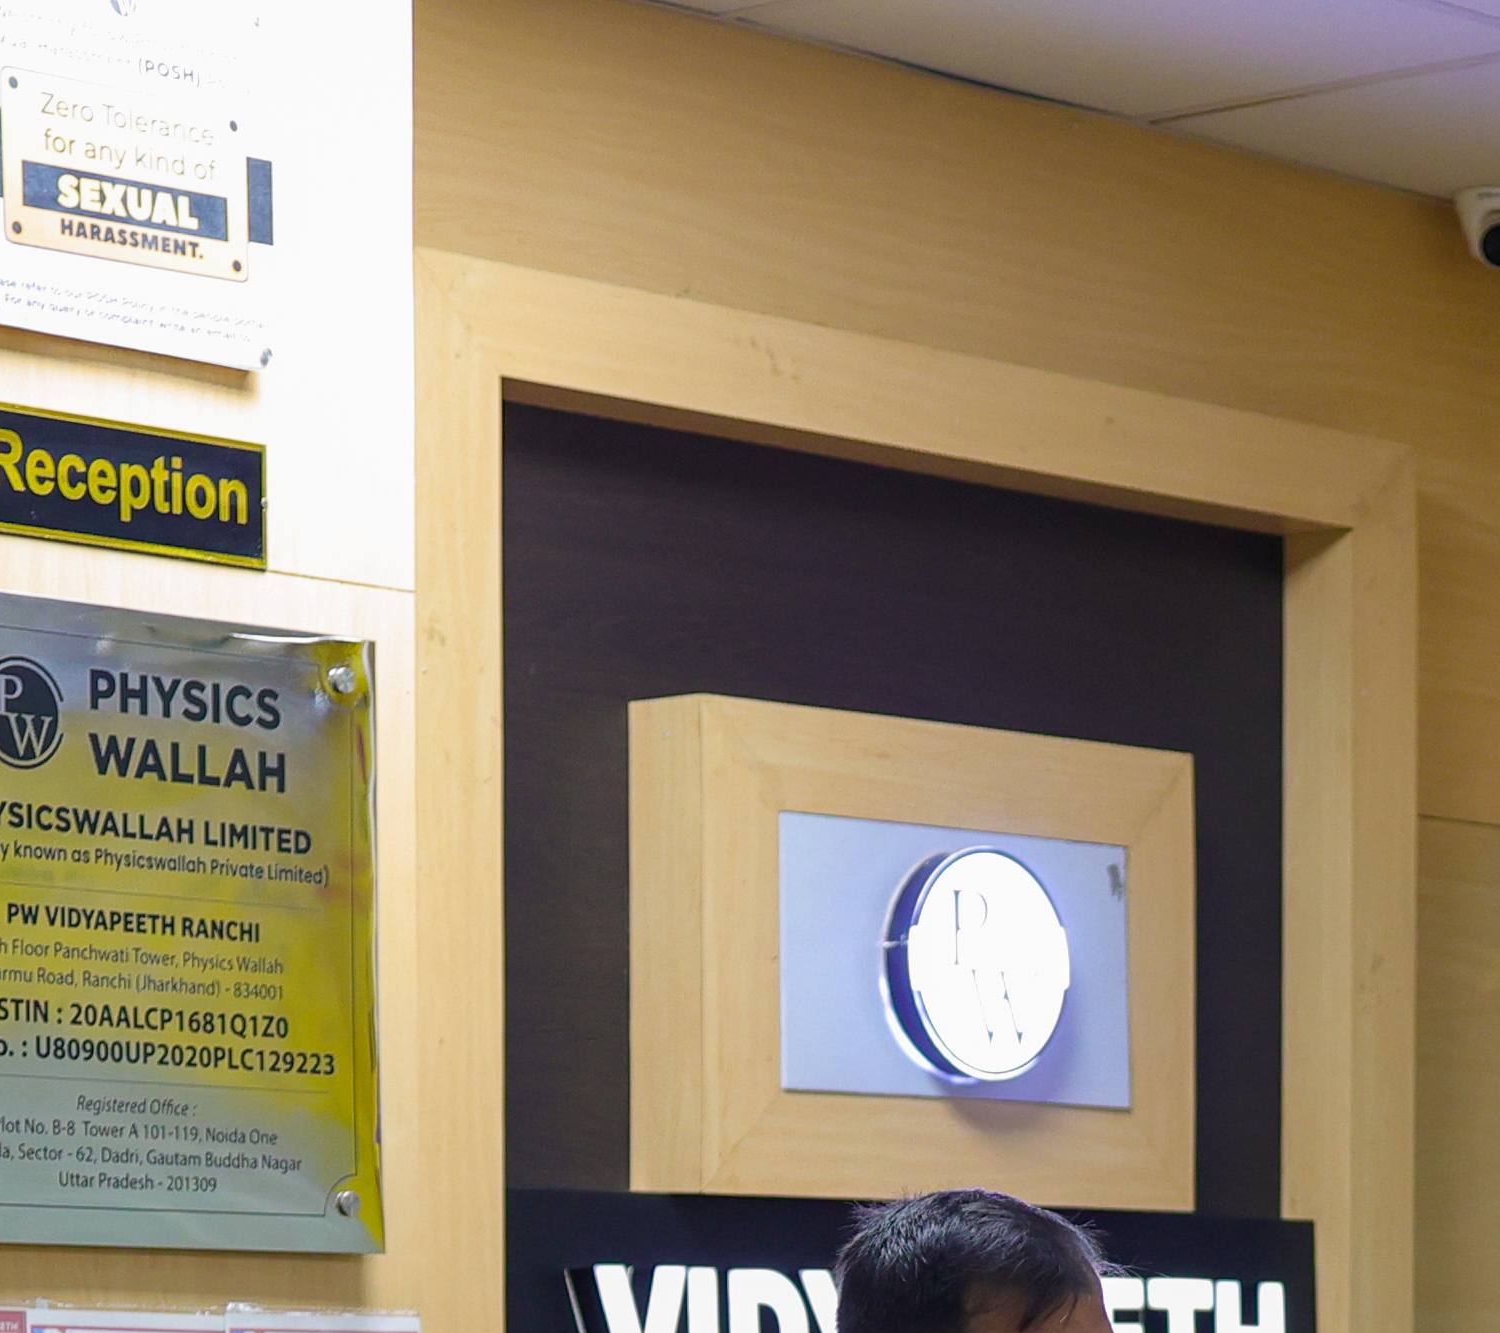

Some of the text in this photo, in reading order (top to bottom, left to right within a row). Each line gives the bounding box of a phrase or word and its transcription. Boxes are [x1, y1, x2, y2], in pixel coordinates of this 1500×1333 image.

[40, 92, 215, 146] Zero Tolerance
[44, 129, 216, 181] for any kind of
[57, 173, 199, 230] SEXUAL
[61, 218, 203, 259] HARASSMENT.
[89, 669, 280, 730] PHYSICS
[89, 733, 286, 793] WALLAH
[204, 821, 311, 854] LIMITED
[14, 841, 67, 862] known
[71, 849, 89, 863] as
[95, 850, 206, 874] Physicswallah
[211, 859, 264, 880] Private
[268, 863, 329, 887] Limited)
[7, 903, 260, 943] PW VIDYAPEETH RANCHI
[12, 939, 49, 957] Floor
[54, 942, 129, 963] Panchwati
[133, 949, 178, 969] Tower,
[183, 952, 233, 973] Physics
[237, 957, 284, 974] Wallah
[59, 1171, 217, 1192] Uttar Pradesh 201309
